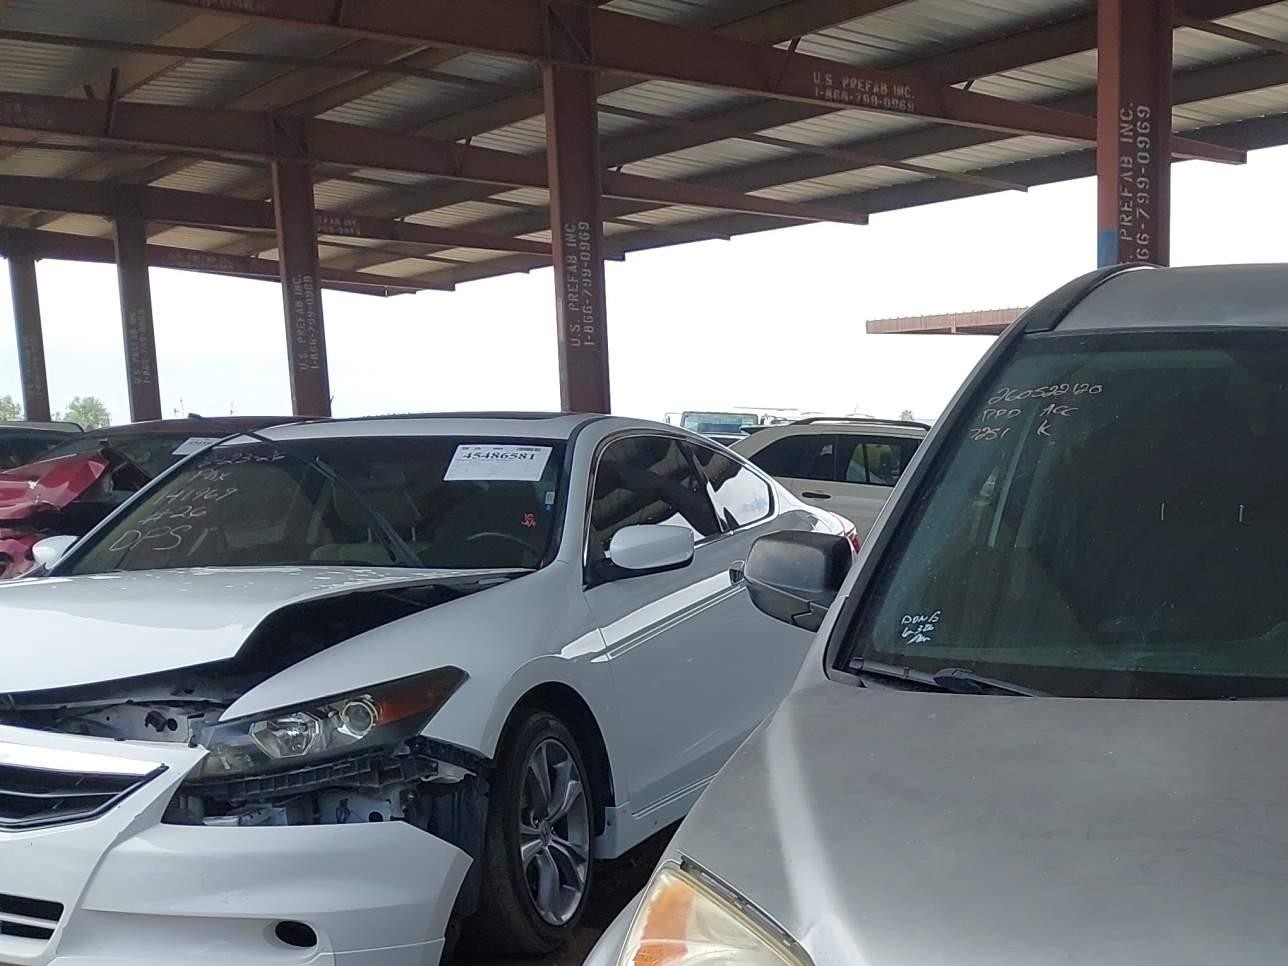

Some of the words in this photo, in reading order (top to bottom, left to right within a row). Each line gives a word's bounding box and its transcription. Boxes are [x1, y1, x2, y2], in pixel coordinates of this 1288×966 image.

[893, 84, 915, 99] INC.
[1119, 102, 1134, 143] INC.
[1119, 156, 1134, 241] PREFAB
[1136, 105, 1150, 265] 66-799-0969
[566, 255, 580, 311] PREFAB
[578, 221, 596, 346] 1-866-799-0969
[569, 319, 581, 347] U.S.
[1036, 419, 1052, 436] K
[463, 452, 536, 460] 45486581
